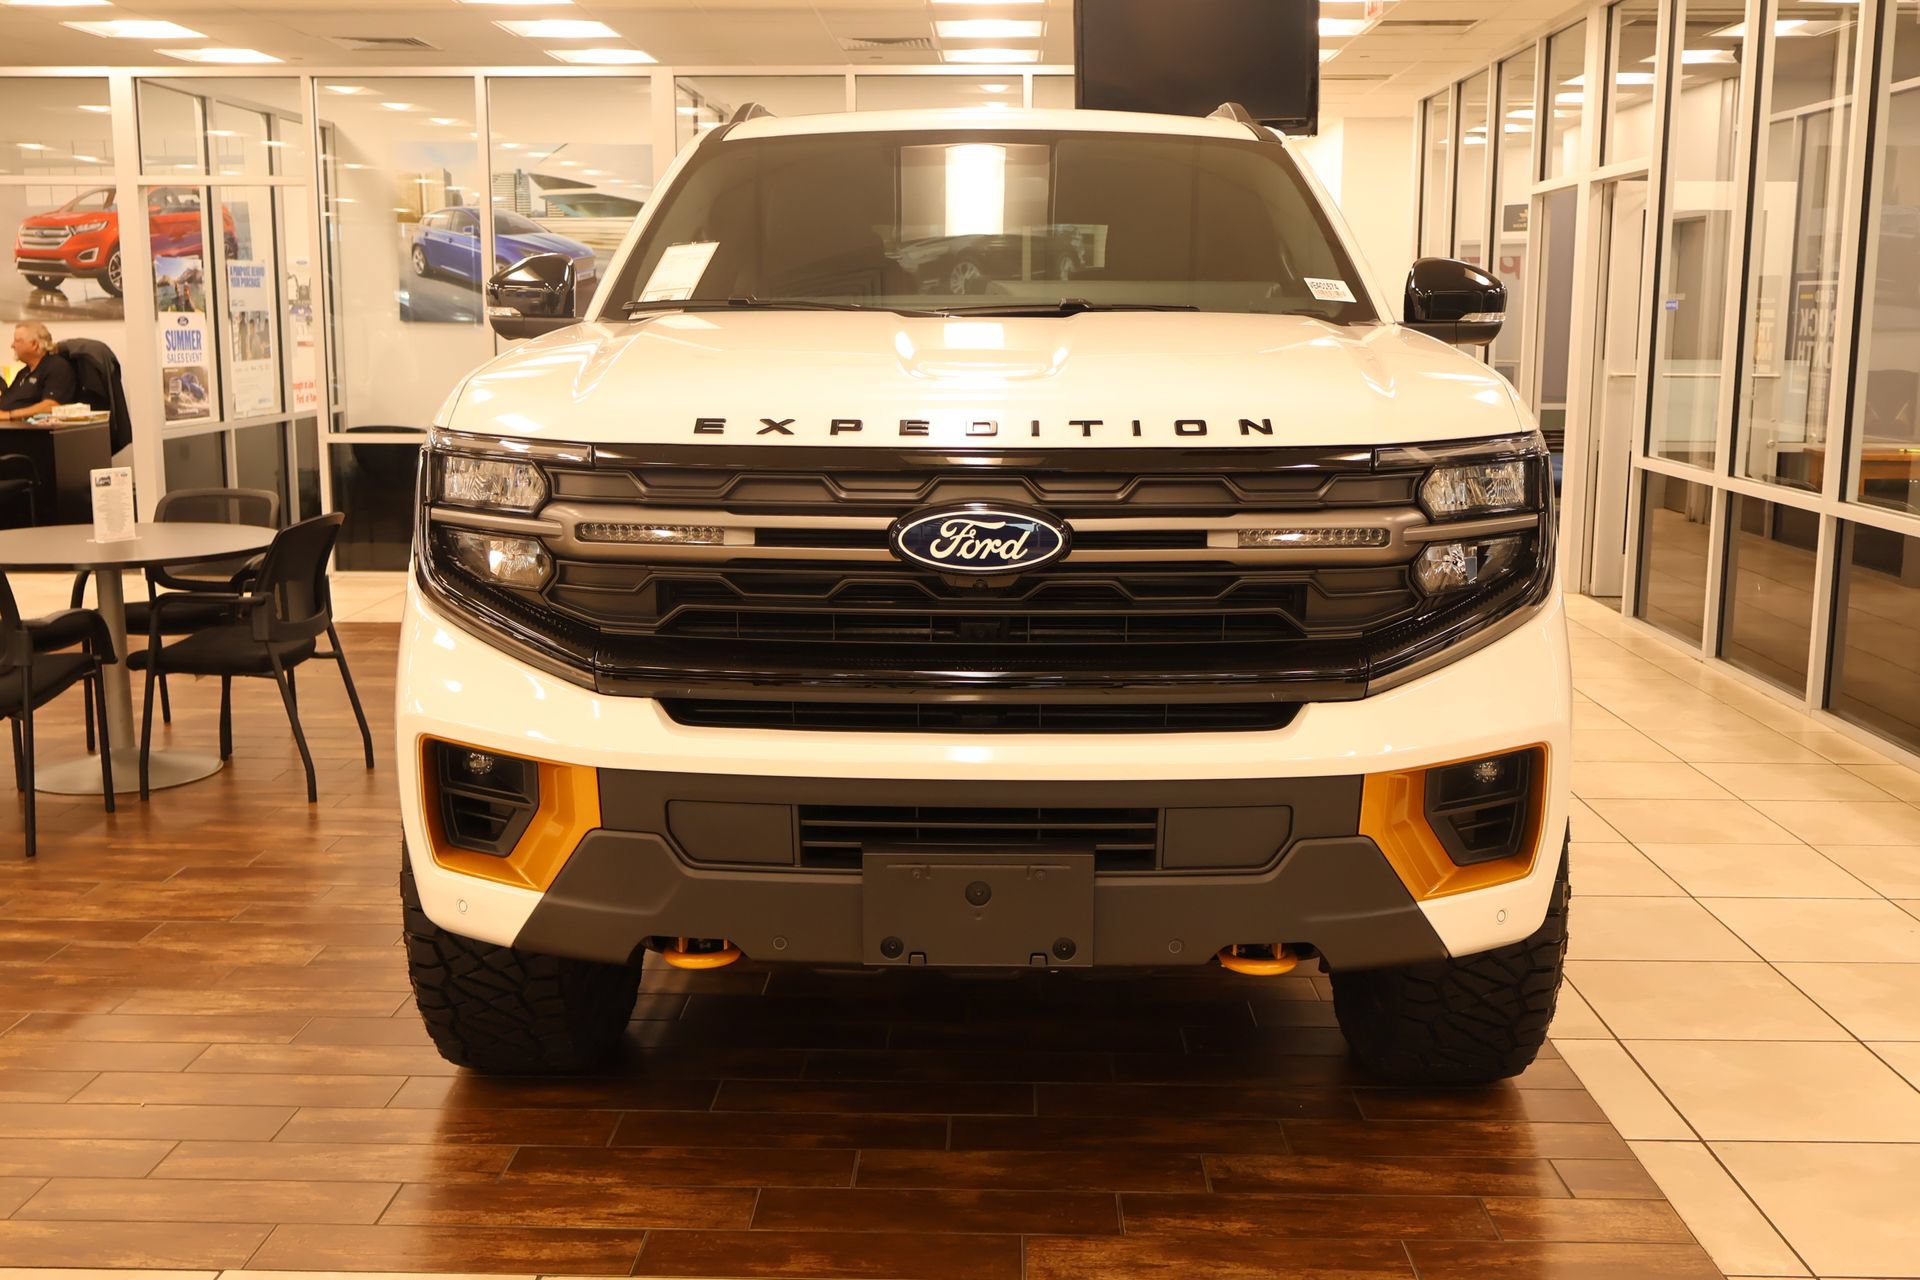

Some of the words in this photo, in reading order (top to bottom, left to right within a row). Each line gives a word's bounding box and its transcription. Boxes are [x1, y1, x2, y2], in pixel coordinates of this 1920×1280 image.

[165, 329, 202, 351] SUMMER
[167, 352, 185, 364] SALES
[185, 351, 203, 363] EVENT
[693, 417, 1274, 436] EXPEDITION
[929, 518, 1031, 560] Ford
